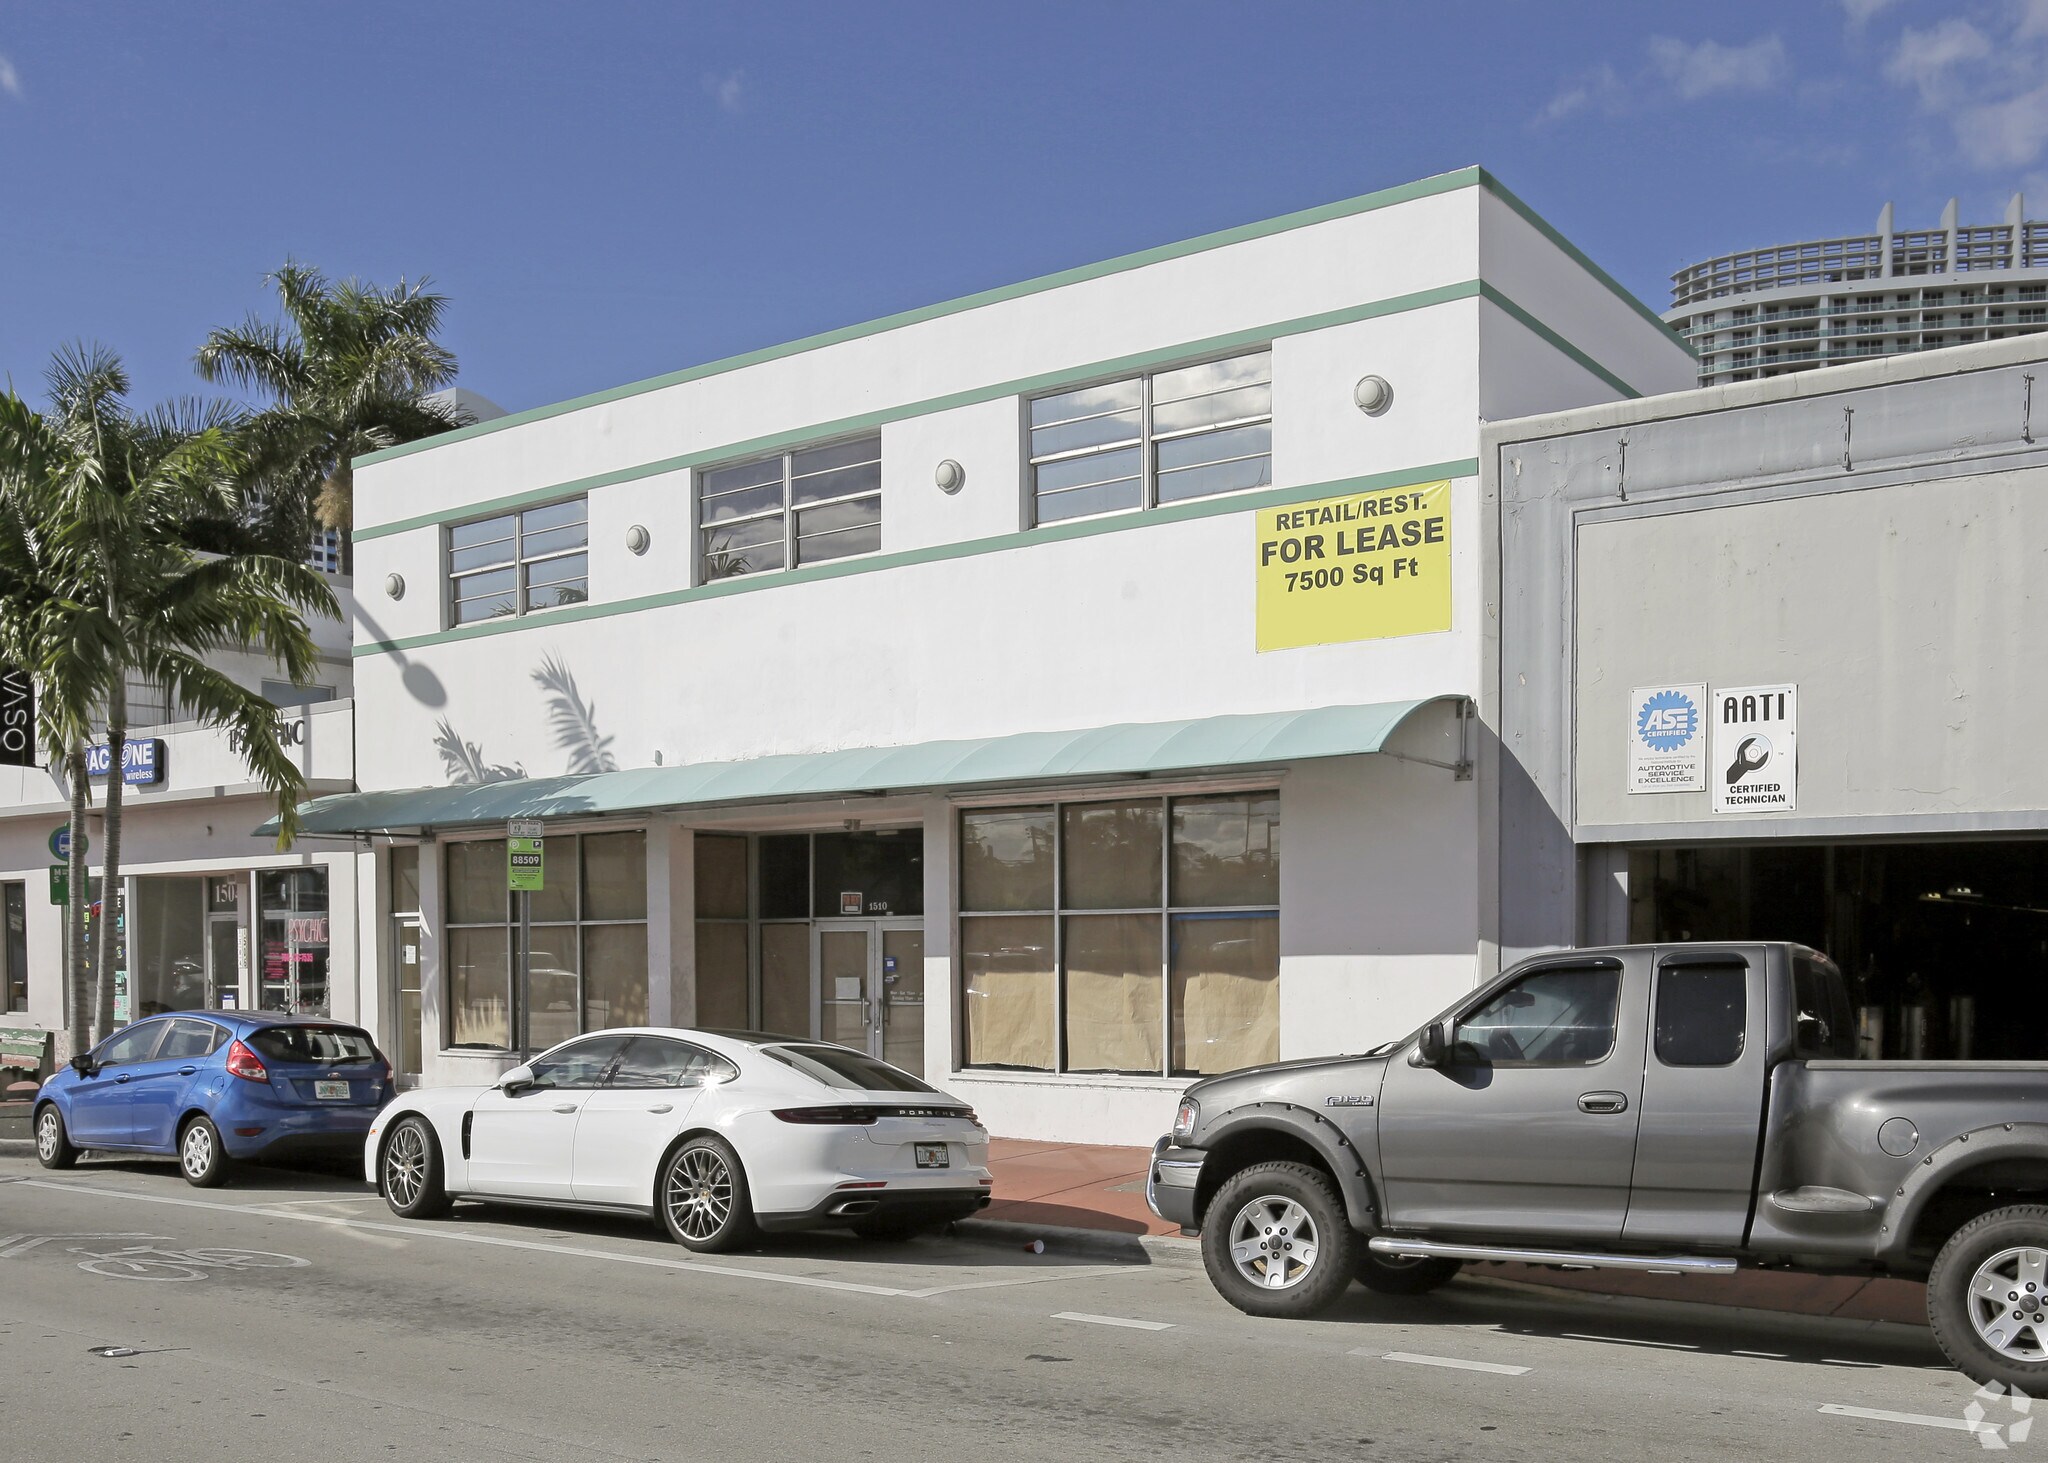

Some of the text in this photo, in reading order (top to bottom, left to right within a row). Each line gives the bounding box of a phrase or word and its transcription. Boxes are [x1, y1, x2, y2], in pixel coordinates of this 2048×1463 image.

[1276, 492, 1427, 531] RETAIL/REST.
[1262, 516, 1444, 566] FOR LEASE
[1285, 557, 1418, 592] 7500 Sq Ft
[1723, 693, 1785, 724] AATI
[1644, 707, 1688, 731] ASE
[1647, 729, 1687, 737] CERTIFIED
[126, 768, 153, 781] wireless
[1730, 783, 1781, 794] CERTIFIED
[1725, 794, 1786, 805] TECHNICIAN
[512, 855, 539, 864] 88509
[53, 868, 61, 876] M
[215, 884, 238, 902] 150
[869, 901, 887, 911] 1510
[288, 917, 328, 942] PSYCHIC
[899, 1109, 955, 1117] PORSCHE
